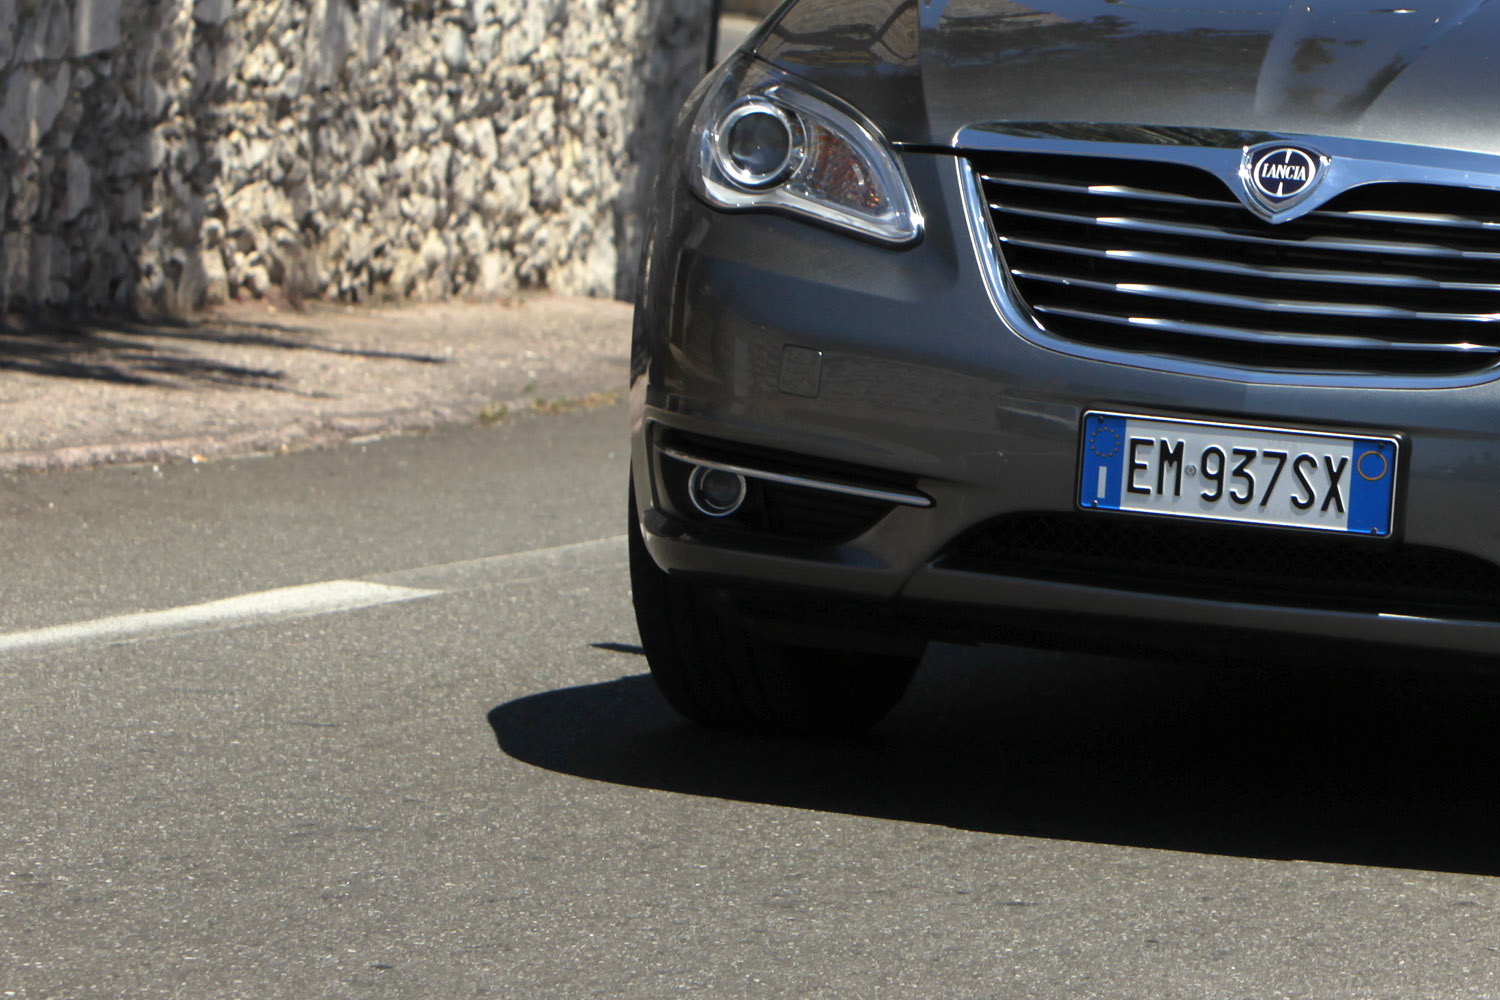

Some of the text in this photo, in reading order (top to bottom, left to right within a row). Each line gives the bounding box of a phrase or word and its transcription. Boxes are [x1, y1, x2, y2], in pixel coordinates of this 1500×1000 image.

[1261, 162, 1307, 181] LANCIA
[1126, 436, 1350, 514] EM 937SX
